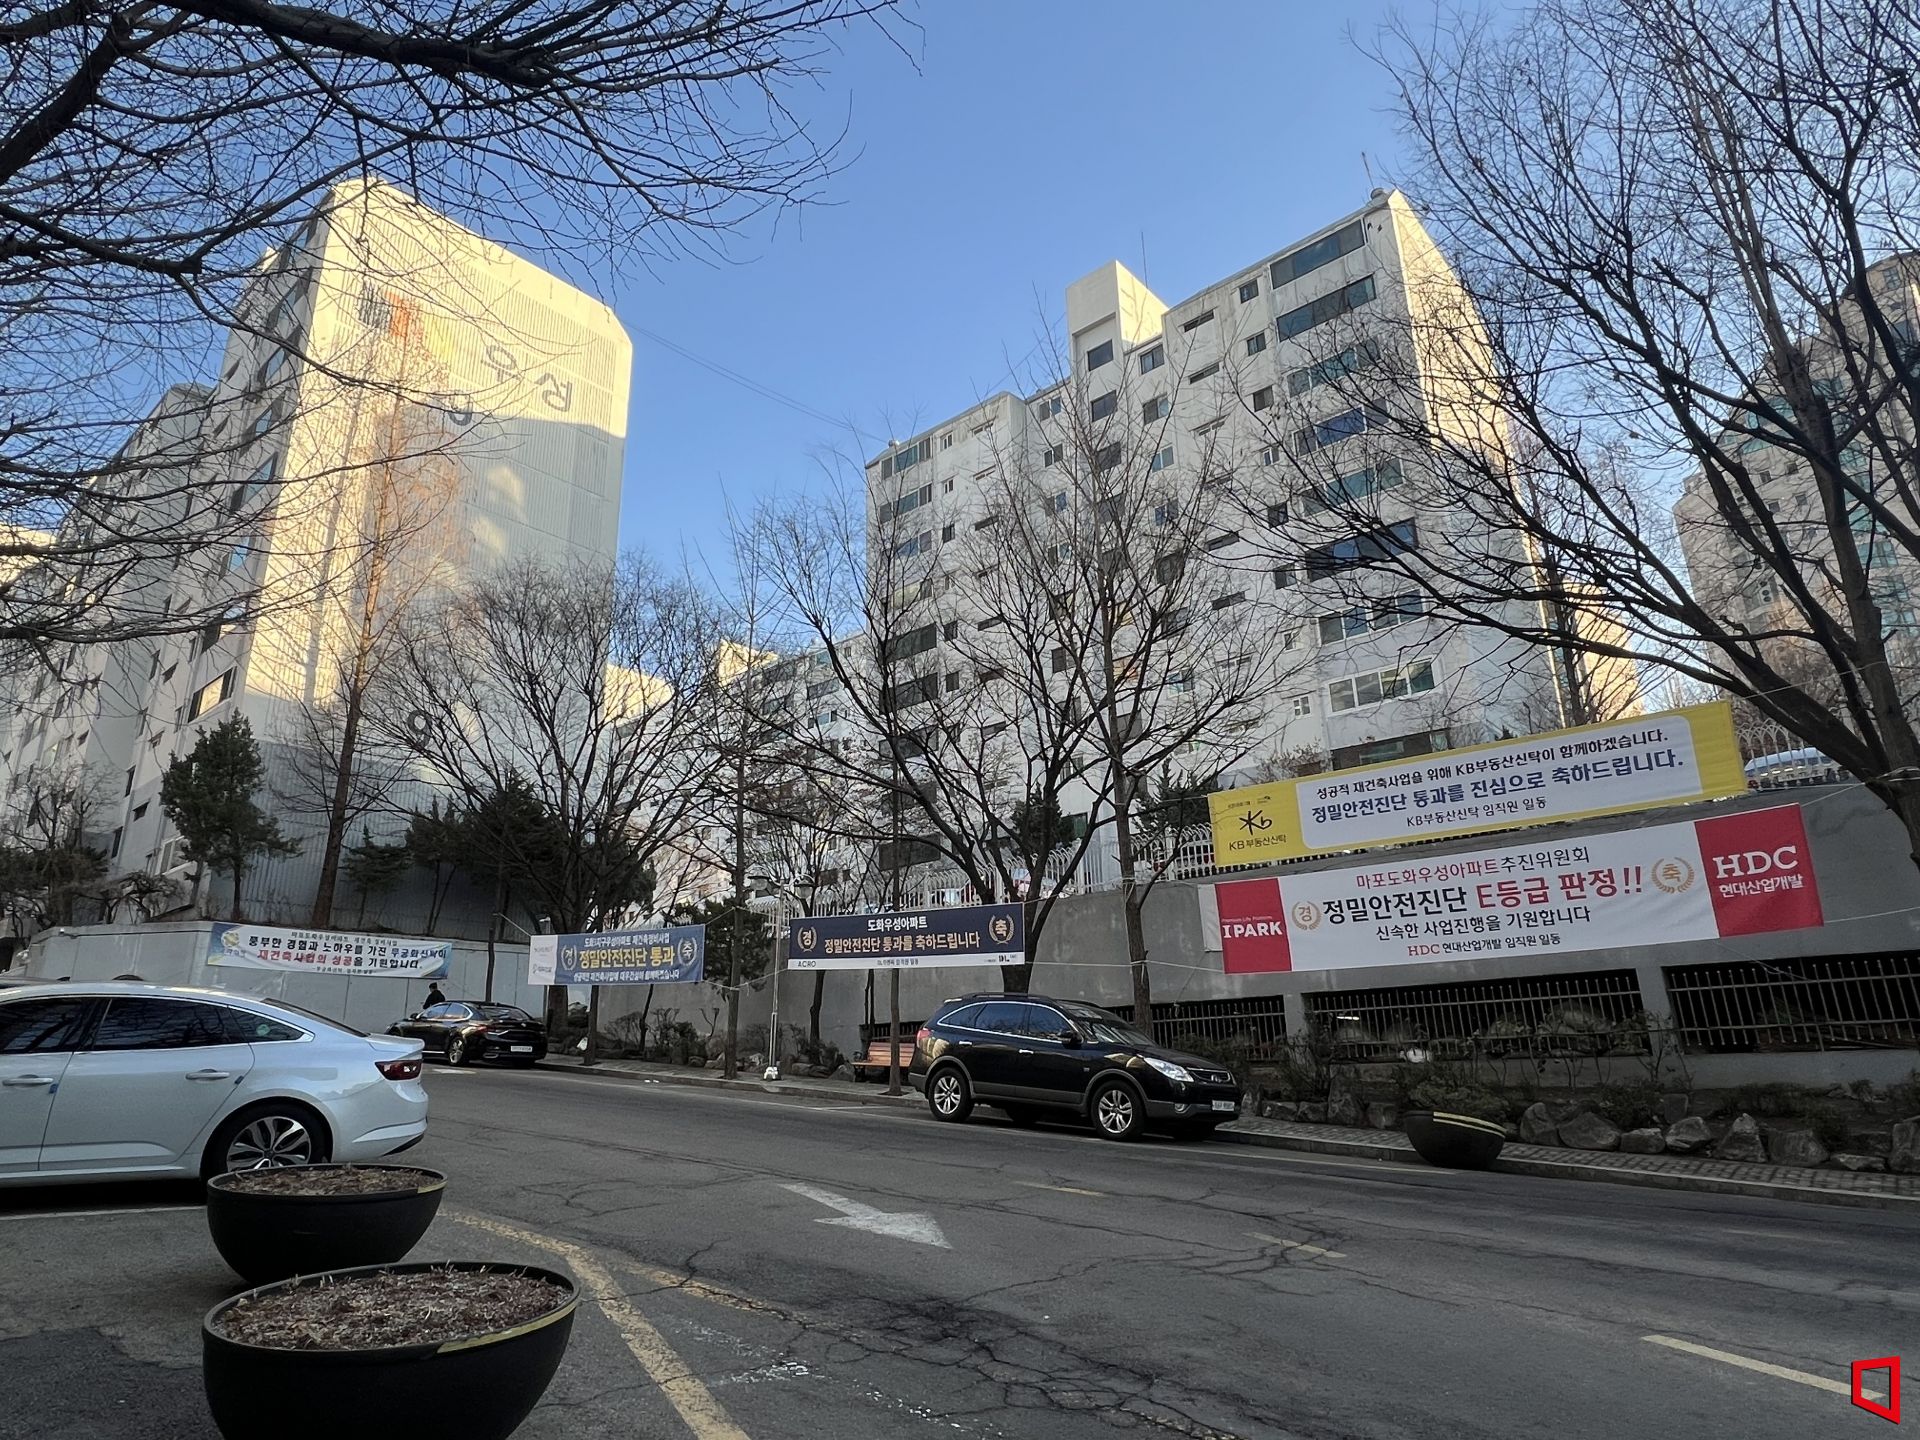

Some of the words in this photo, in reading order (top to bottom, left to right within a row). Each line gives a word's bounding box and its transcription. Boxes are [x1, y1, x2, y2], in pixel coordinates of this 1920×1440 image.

[1317, 783, 1350, 800] 성공적
[1353, 771, 1423, 793] 재건축사업을
[1427, 765, 1452, 781] 위해
[1455, 748, 1555, 777] KB부동산신탁이
[1559, 728, 1668, 760] 함께하겠습니다.
[1311, 793, 1408, 824] 정밀안전진단
[1413, 783, 1465, 808] 통과를
[1470, 771, 1546, 799] 진심으로
[1551, 749, 1684, 785] 축하드립니다.
[1407, 806, 1479, 827] KB부동산신탁
[1482, 799, 1519, 817] 임직원
[1523, 796, 1547, 811] 일동
[1662, 862, 1682, 883] 축
[1712, 845, 1799, 878] HDC
[1322, 886, 1468, 924] 정밀안전진단
[1475, 876, 1550, 909] E등급
[1557, 865, 1642, 901] 판정!!
[1719, 873, 1805, 898] 현대산업개발
[867, 915, 928, 932] 도화우성아파트
[1298, 904, 1312, 922] 경
[1376, 922, 1419, 941] 신속한
[1424, 914, 1501, 936] 사업진행을
[1506, 905, 1591, 930] 기원합니다
[802, 930, 812, 946] 경
[994, 919, 1007, 937] 축
[249, 935, 282, 949] 풍부한
[287, 939, 319, 952] 경험과
[322, 942, 363, 954] 노하우를
[367, 945, 387, 957] 가진
[391, 947, 447, 959] 무궁화신탁이
[682, 940, 694, 961] 축
[824, 936, 881, 953] 정밀안전진단
[882, 935, 913, 952] 통과를
[915, 931, 980, 951] 축하드립니다
[1407, 943, 1441, 957] HDC
[1442, 938, 1502, 954] 현대산업개발
[1504, 935, 1537, 949] 임직원
[1539, 932, 1561, 945] 일동
[257, 949, 327, 964] 재건축사업의
[332, 954, 363, 967] 성공을
[368, 957, 422, 969] 기원합니다.
[564, 947, 573, 965] 경
[579, 947, 648, 969] 정밀안전진단
[650, 945, 675, 967] 통과
[797, 960, 817, 968] ACRO
